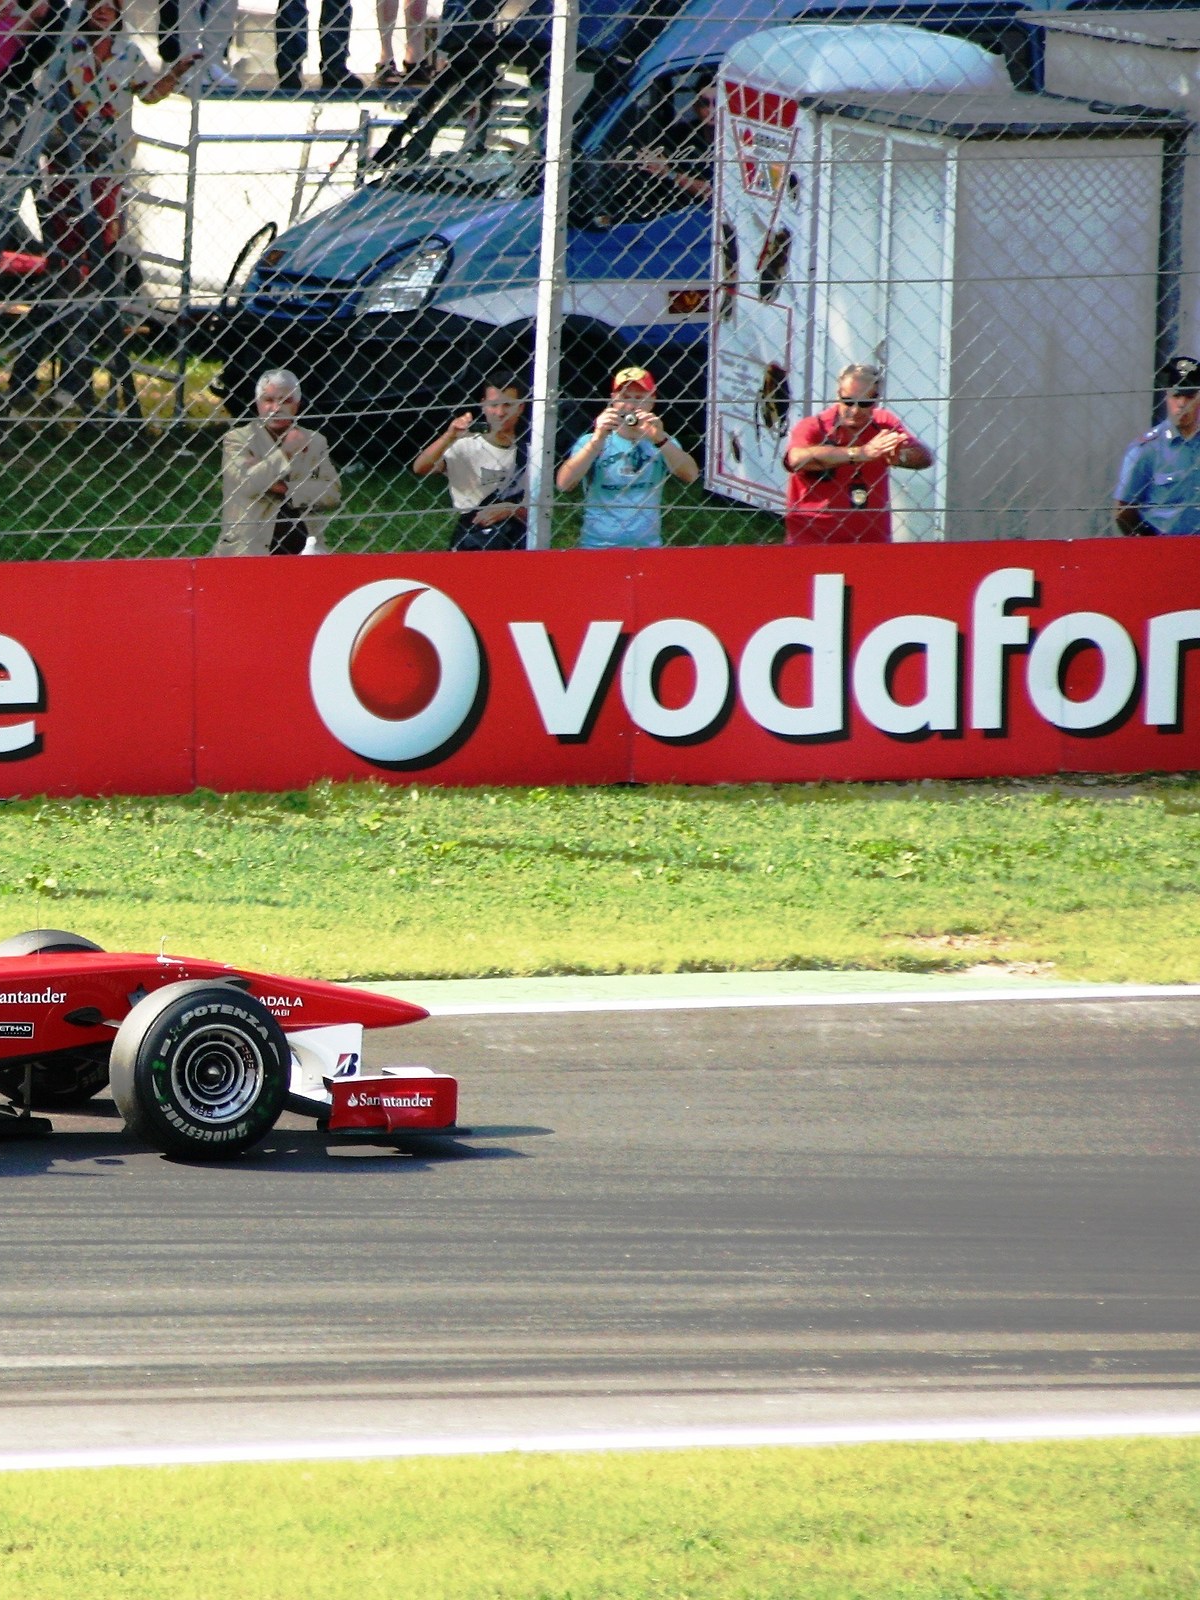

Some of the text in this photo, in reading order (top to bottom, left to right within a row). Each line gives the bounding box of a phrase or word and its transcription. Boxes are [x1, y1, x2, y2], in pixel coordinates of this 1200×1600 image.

[259, 995, 304, 1007] ADALA
[180, 1003, 269, 1040] POTENZA
[159, 1103, 249, 1142] BRIDGESTONE
